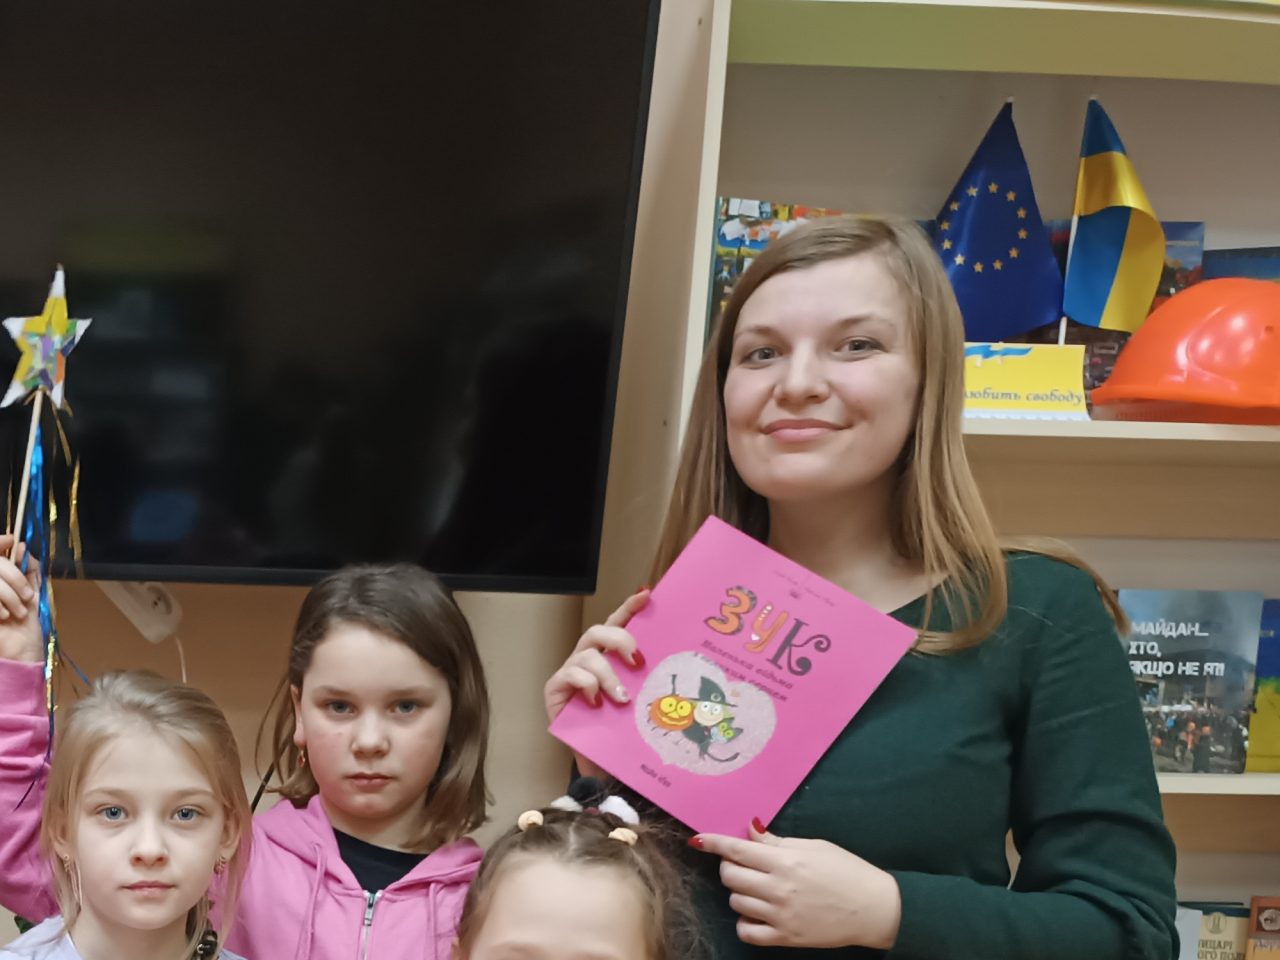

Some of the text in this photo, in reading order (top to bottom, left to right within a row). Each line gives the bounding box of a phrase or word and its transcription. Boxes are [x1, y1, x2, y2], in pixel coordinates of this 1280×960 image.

[1026, 389, 1083, 406] свободу
[704, 585, 832, 677] ЗУК
[1177, 661, 1200, 676] НЕ
